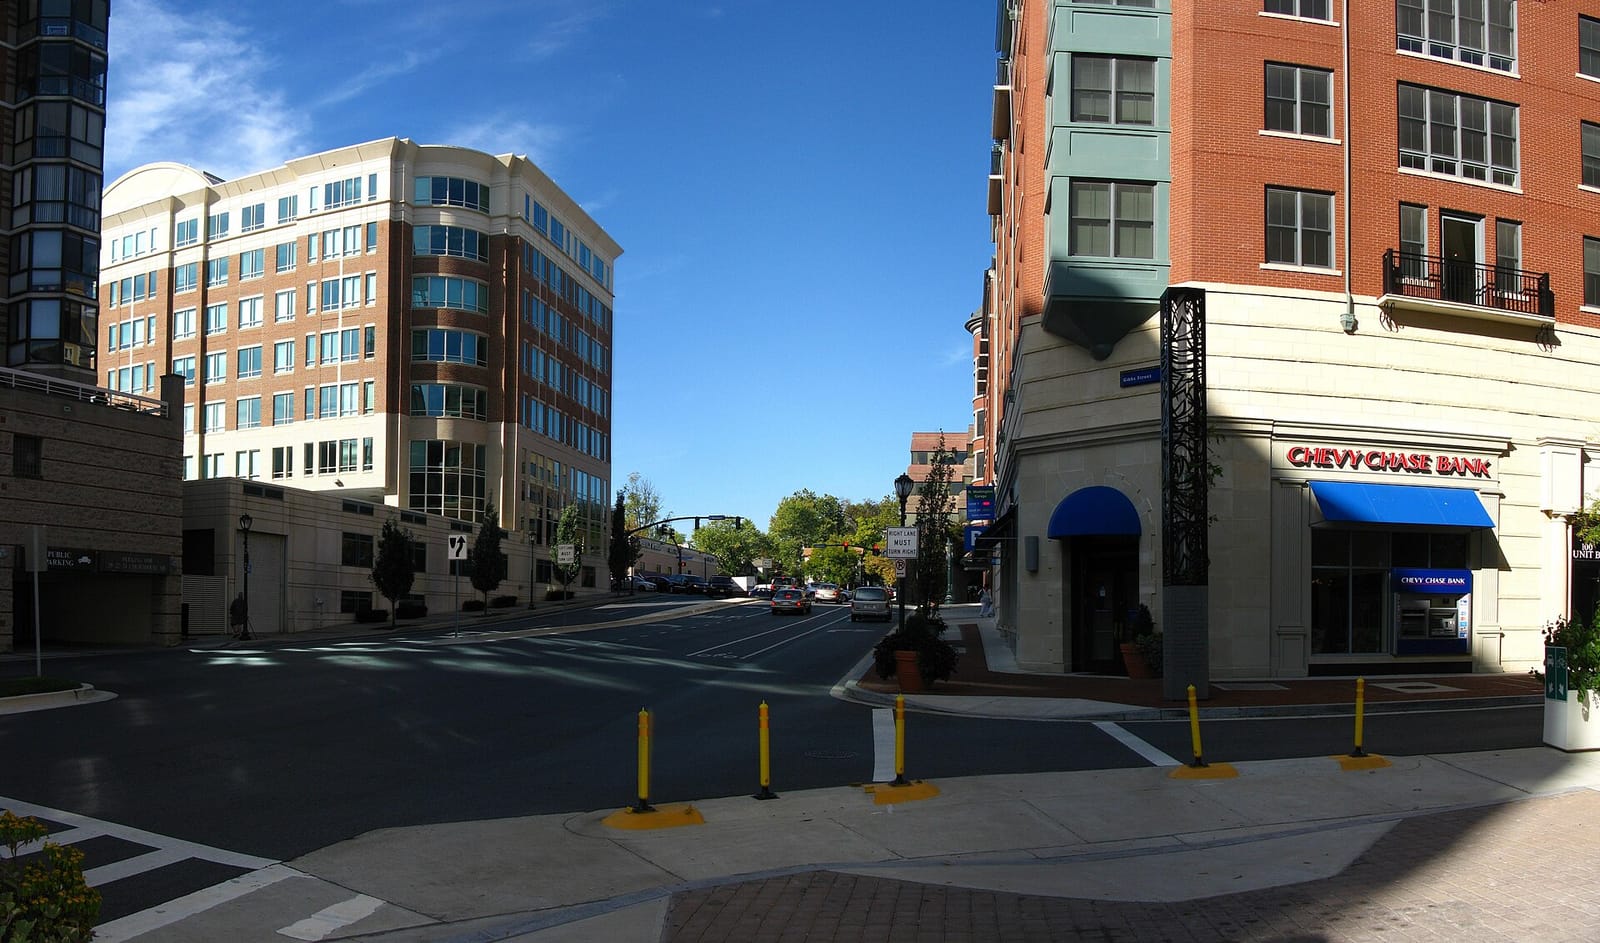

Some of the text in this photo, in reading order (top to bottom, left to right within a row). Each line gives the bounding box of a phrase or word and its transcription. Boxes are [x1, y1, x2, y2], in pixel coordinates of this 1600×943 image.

[1287, 446, 1490, 476] CHEVY CHASE BANK
[1573, 550, 1594, 559] UNIT
